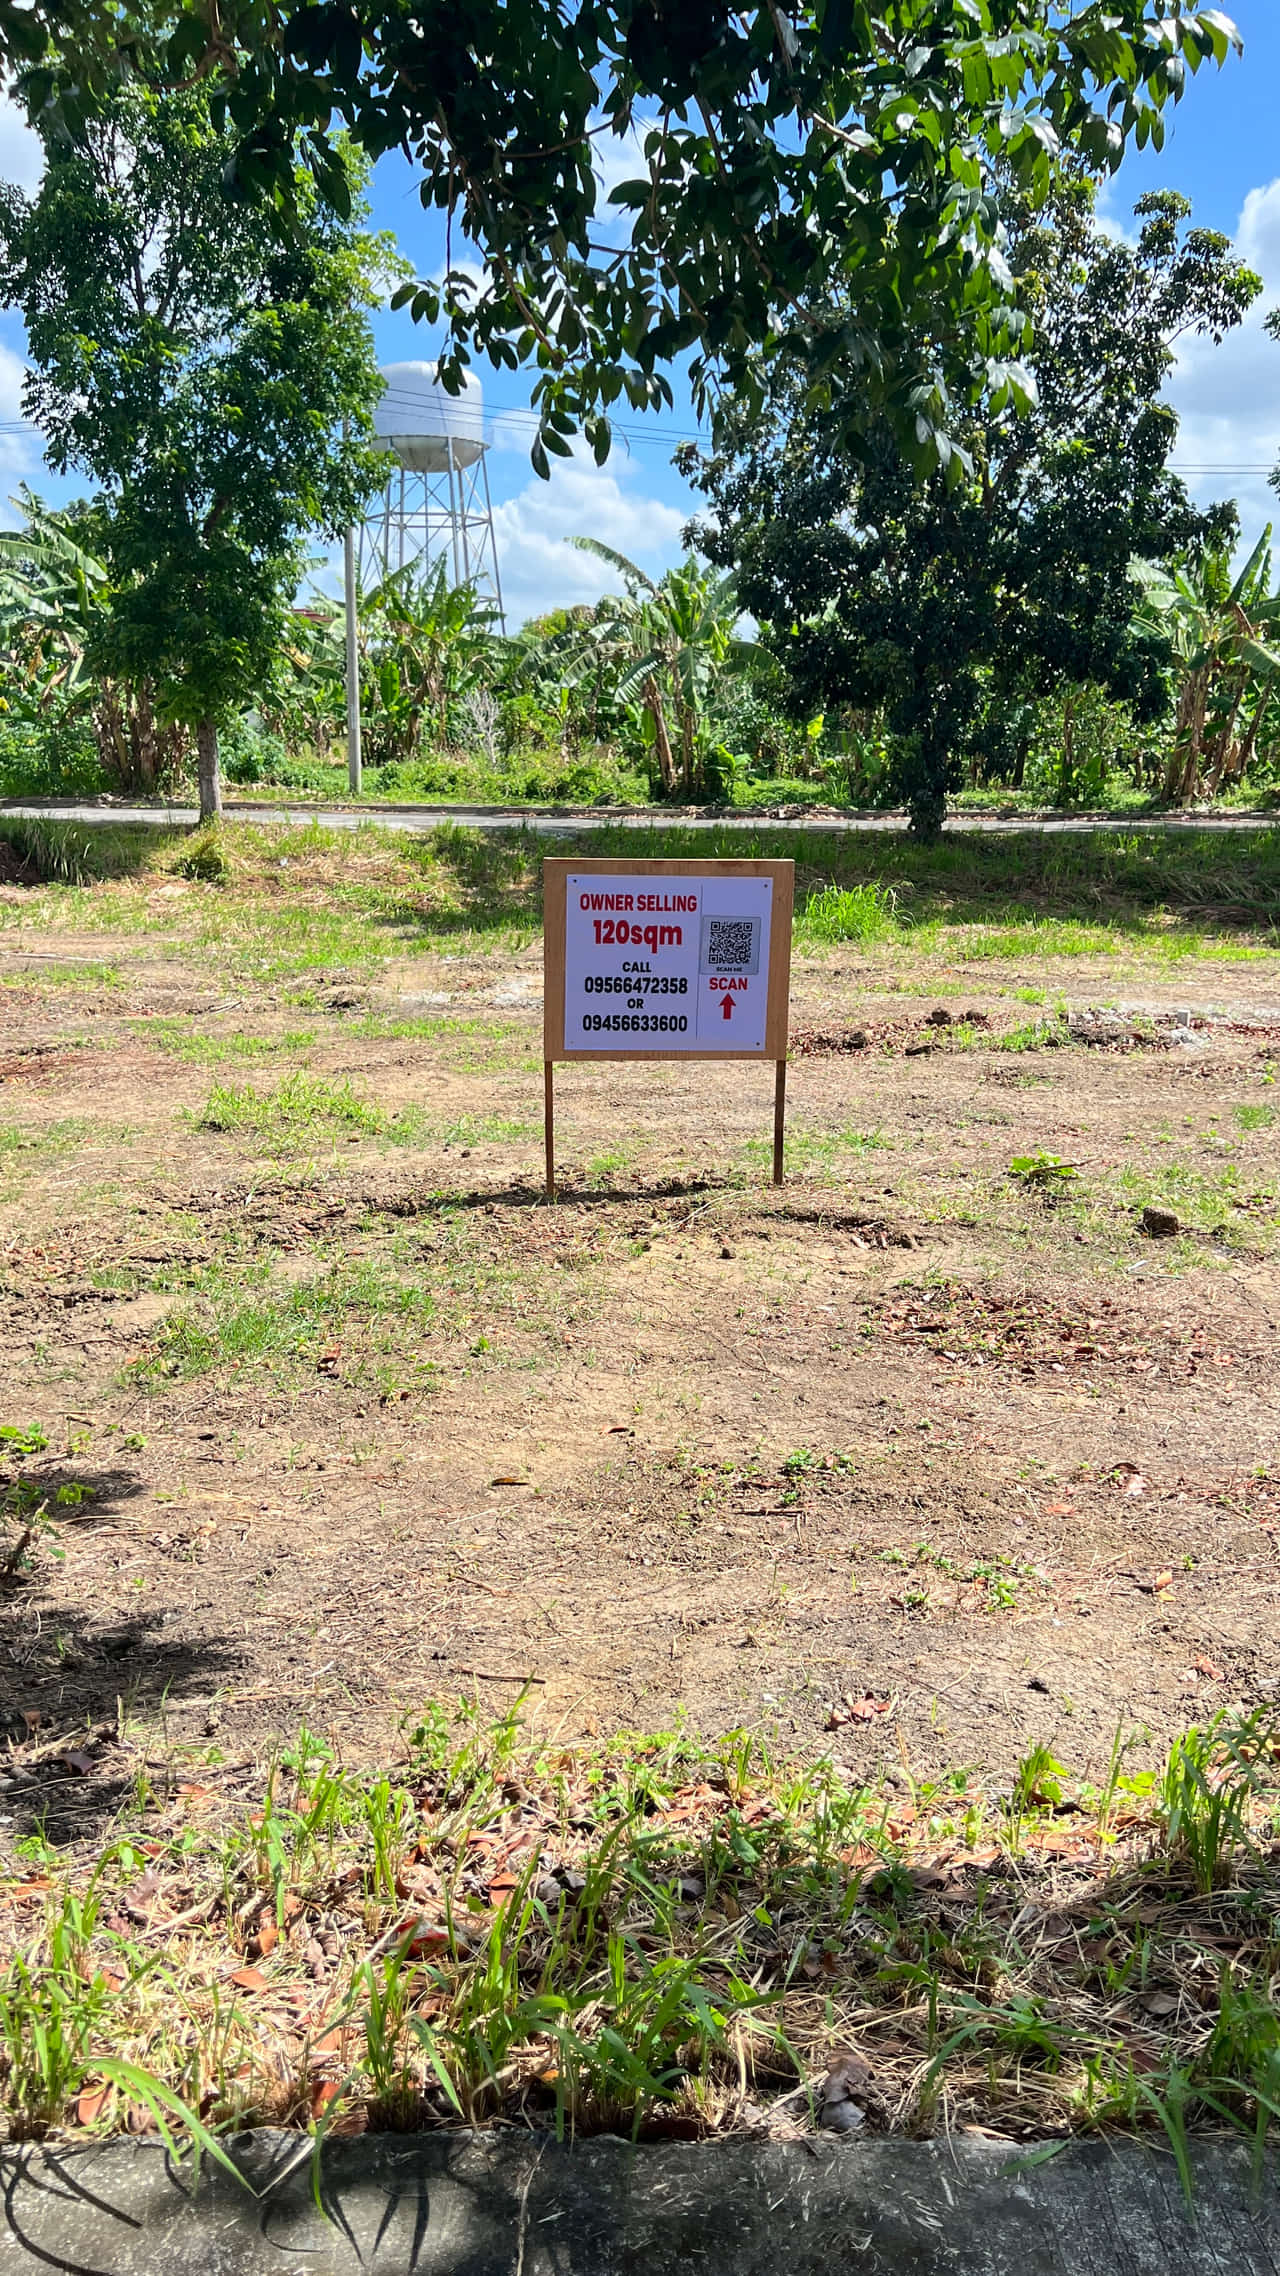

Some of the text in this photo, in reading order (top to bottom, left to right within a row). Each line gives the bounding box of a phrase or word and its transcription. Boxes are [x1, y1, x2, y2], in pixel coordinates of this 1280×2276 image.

[580, 893, 698, 912] OWNER SELLING
[593, 919, 682, 954] 120sqm
[622, 962, 652, 973] CALL
[584, 976, 688, 994] 09566472358
[709, 977, 748, 990] SCAN
[627, 998, 644, 1009] OR
[582, 1015, 688, 1032] 09456633600
